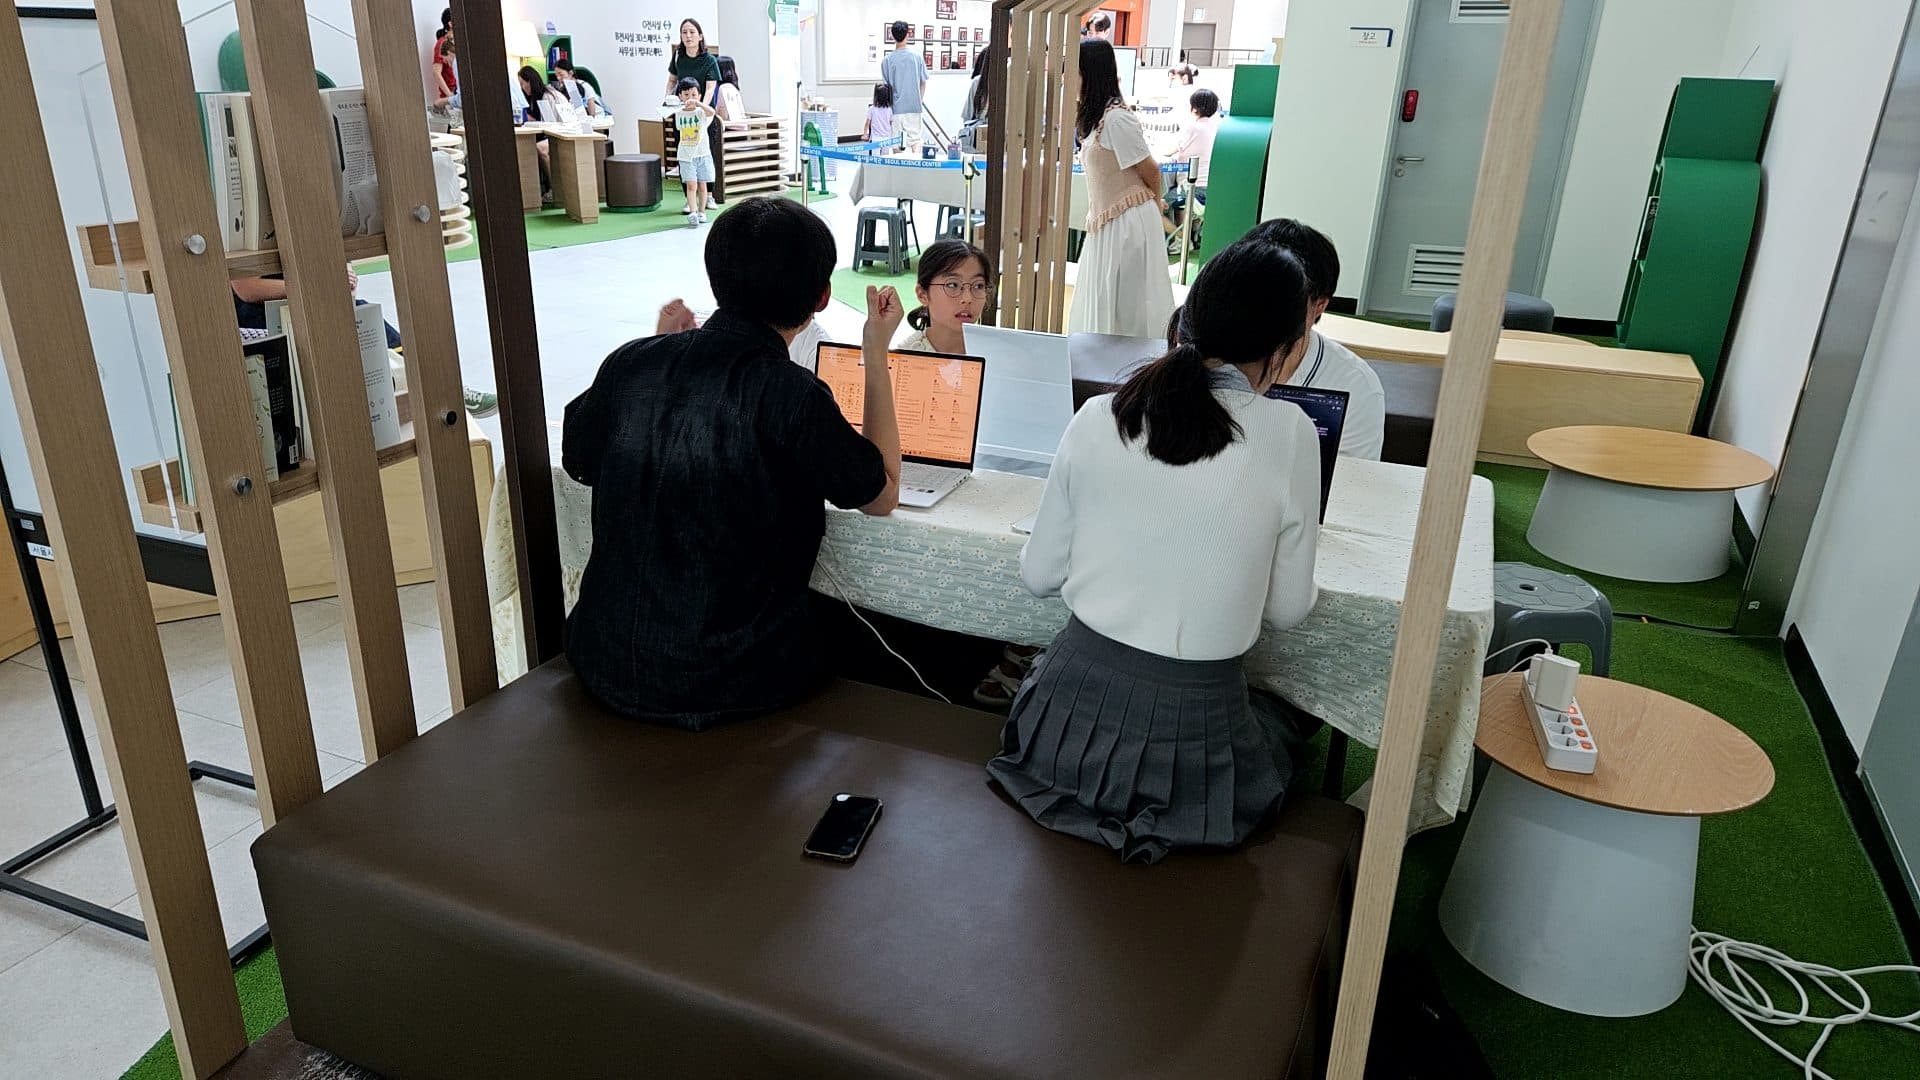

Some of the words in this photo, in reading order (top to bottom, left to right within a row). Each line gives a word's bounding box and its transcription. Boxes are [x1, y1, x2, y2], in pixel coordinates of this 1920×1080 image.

[884, 158, 900, 166] SEOUL
[900, 159, 922, 167] SCIENCE
[922, 160, 942, 168] CENTER
